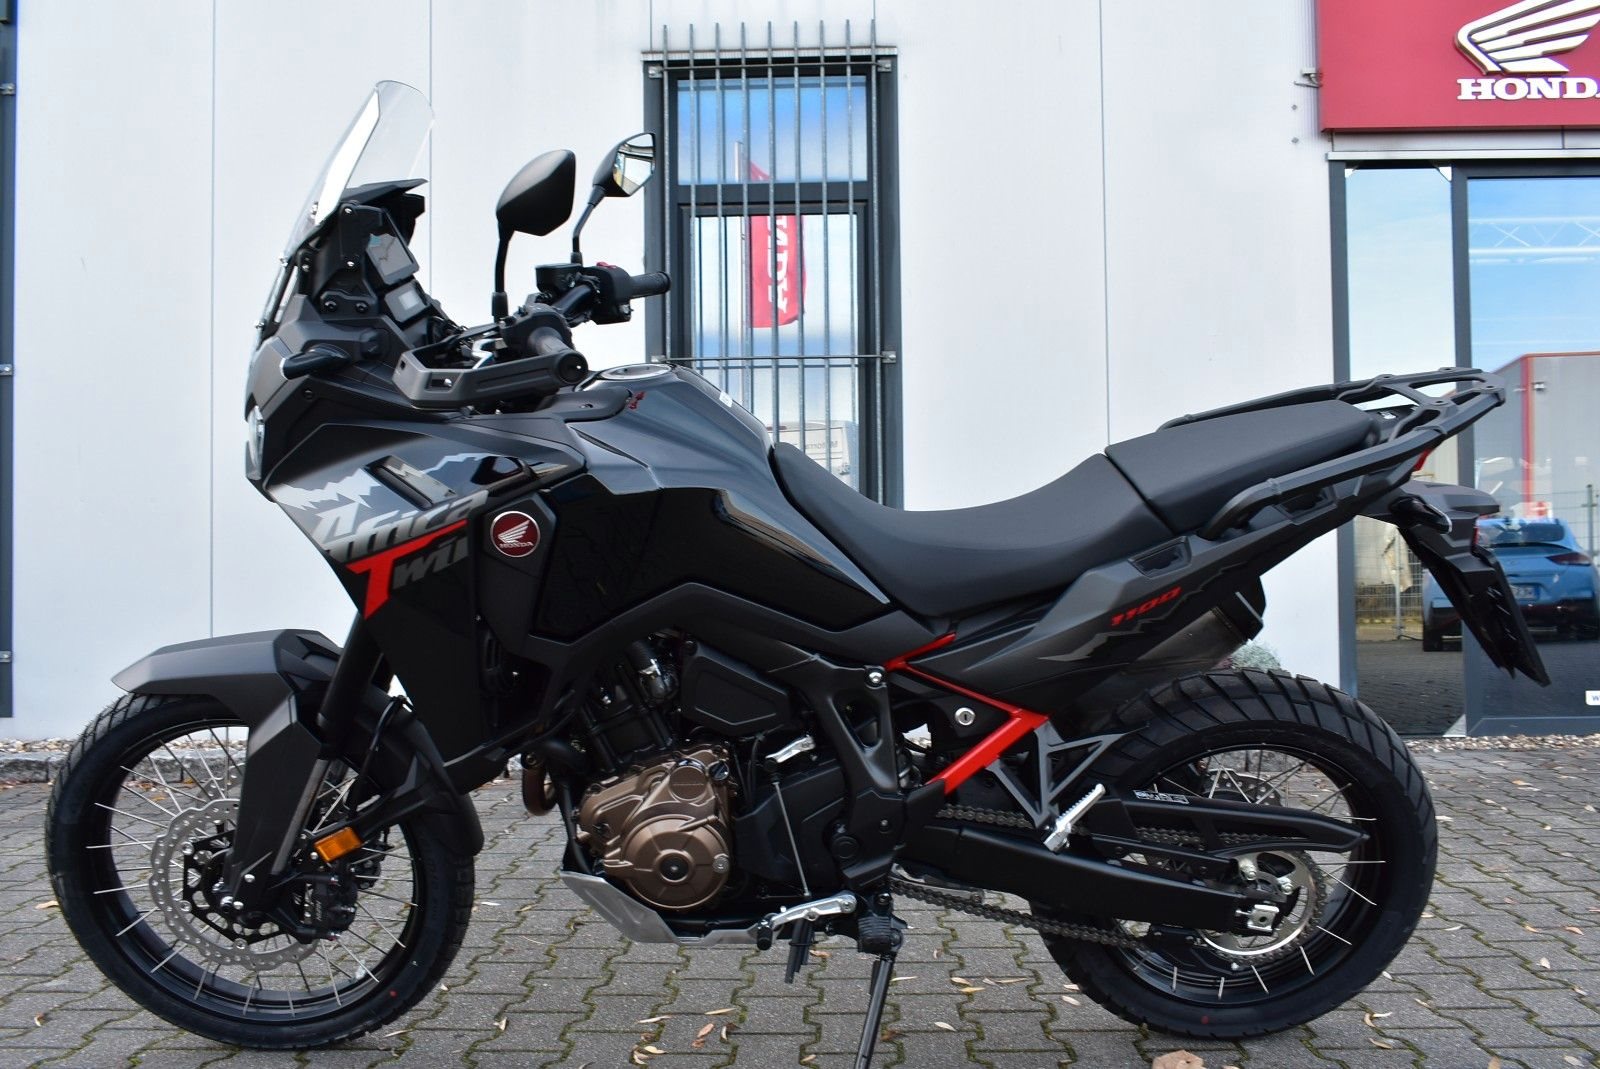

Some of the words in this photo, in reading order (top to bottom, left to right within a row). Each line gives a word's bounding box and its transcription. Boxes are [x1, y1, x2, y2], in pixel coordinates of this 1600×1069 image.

[1456, 77, 1600, 100] HOND
[499, 541, 534, 549] HONDA
[1110, 586, 1183, 626] 1100
